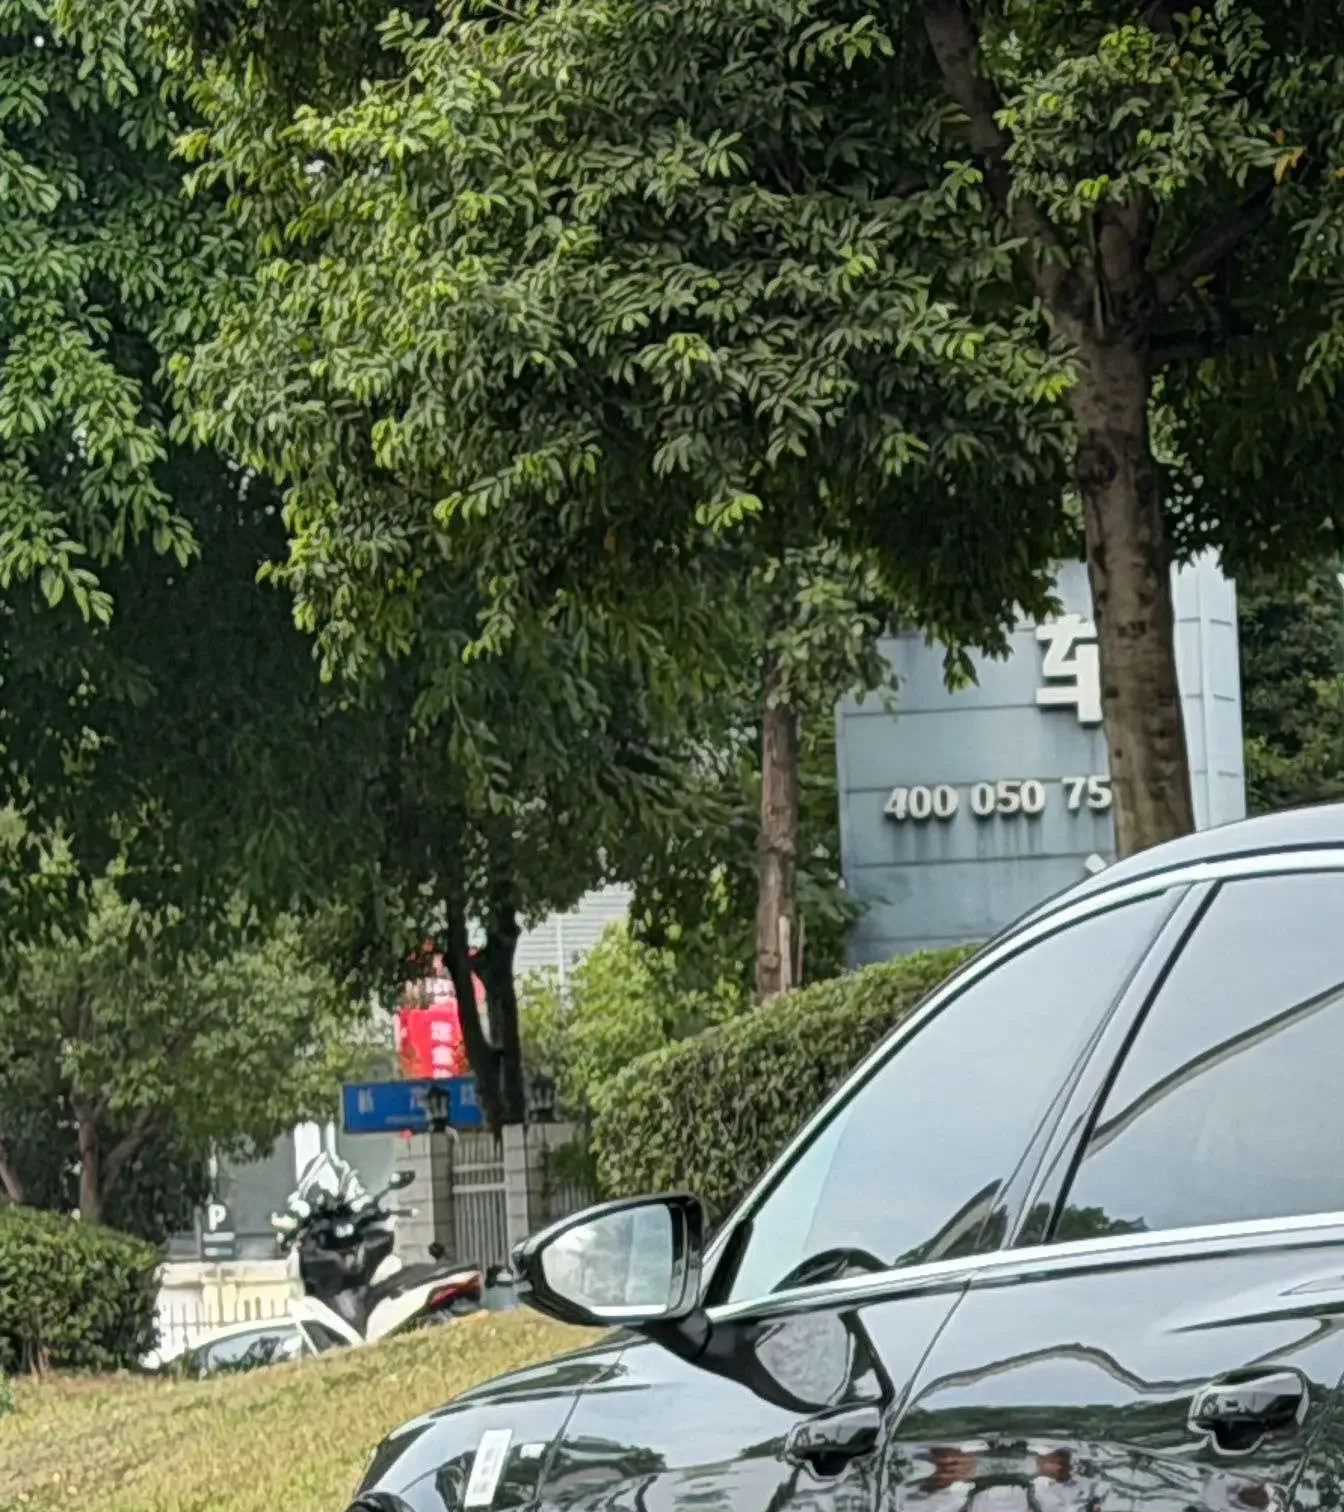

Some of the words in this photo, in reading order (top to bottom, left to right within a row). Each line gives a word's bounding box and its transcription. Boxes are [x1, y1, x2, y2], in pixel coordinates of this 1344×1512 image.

[884, 783, 959, 820] 400
[970, 780, 1046, 816] 050
[208, 1203, 227, 1231] P
